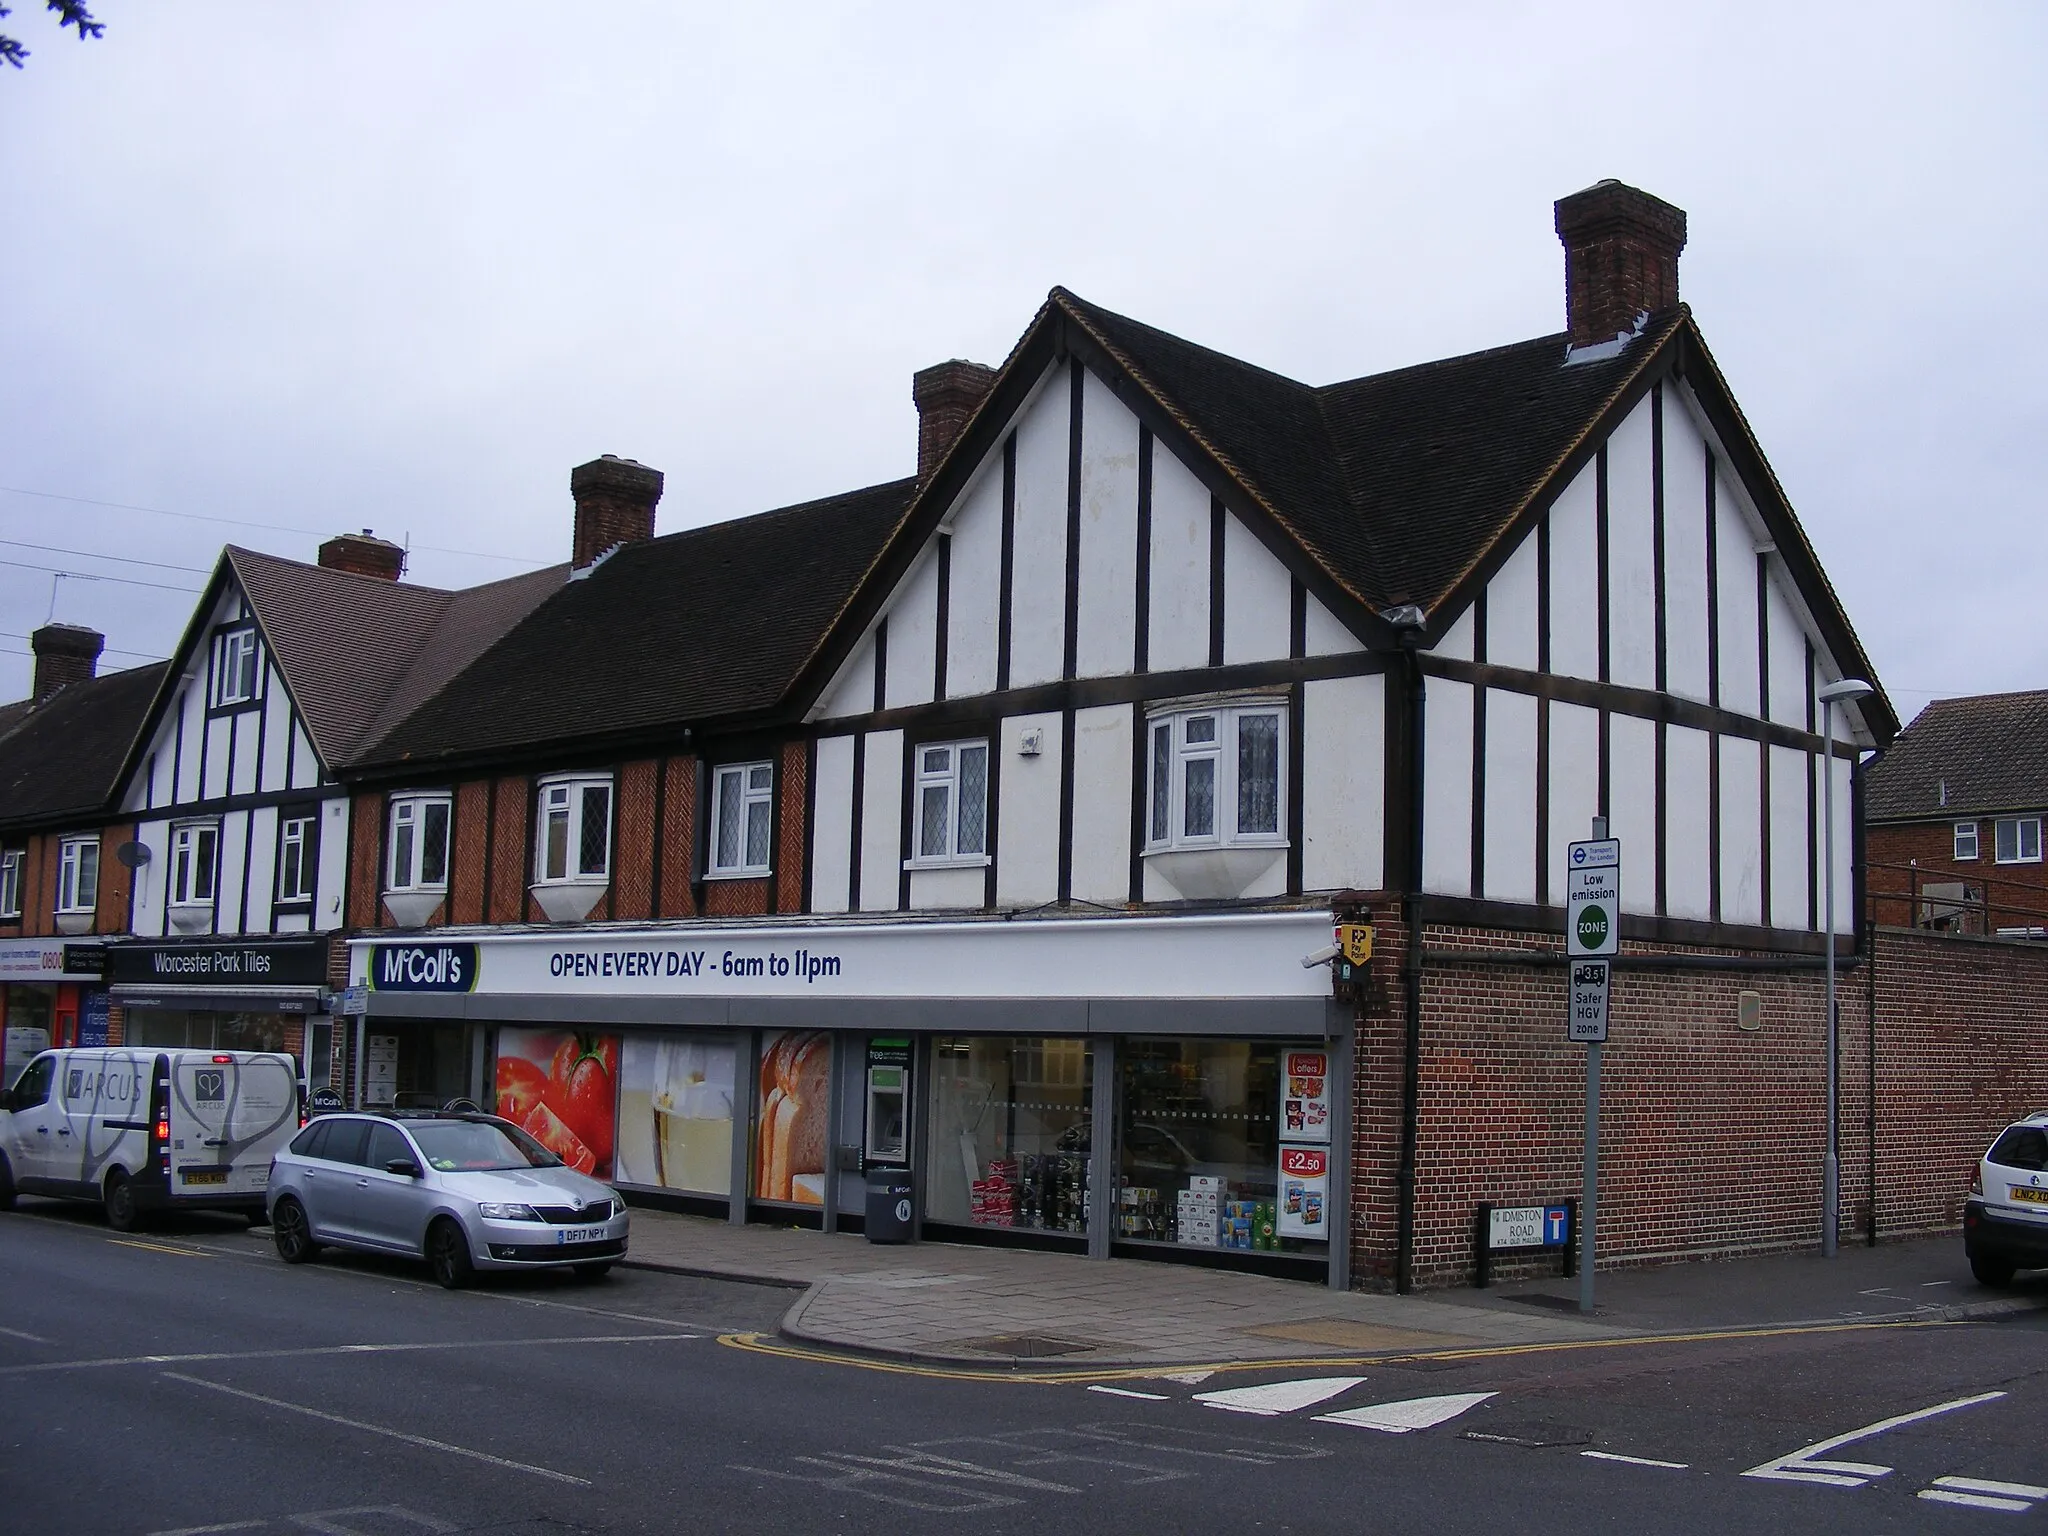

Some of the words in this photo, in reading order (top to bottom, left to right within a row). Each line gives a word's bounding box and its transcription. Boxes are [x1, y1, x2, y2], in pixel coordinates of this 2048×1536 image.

[1583, 874, 1604, 885] Low
[1571, 888, 1615, 901] emission
[1578, 922, 1607, 933] ZONE
[1351, 943, 1361, 952] Pay
[154, 952, 213, 972] Worcester
[214, 951, 241, 972] Park
[243, 950, 271, 972] Tiles
[1351, 951, 1366, 959] Point
[384, 948, 461, 983] McColl's
[550, 953, 598, 977] OPEN
[602, 952, 663, 976] EVERY
[666, 951, 705, 976] DAY
[722, 951, 764, 976] 6am
[768, 953, 790, 976] to
[795, 949, 841, 984] 11pm
[1575, 992, 1602, 1004] Safer
[1577, 1007, 1600, 1019] HGV
[1576, 1025, 1599, 1034] zone
[869, 1050, 884, 1060] free
[1296, 1064, 1318, 1073] offers
[83, 1072, 142, 1102] ARCUS
[196, 1101, 226, 1110] ARCUS
[1288, 1152, 1320, 1170] £2.50
[2014, 1188, 2036, 1200] LN12
[1502, 1210, 1542, 1222] IDMISTON
[566, 1229, 587, 1241] DF17
[588, 1228, 605, 1240] NPY
[1509, 1225, 1535, 1237] ROAD
